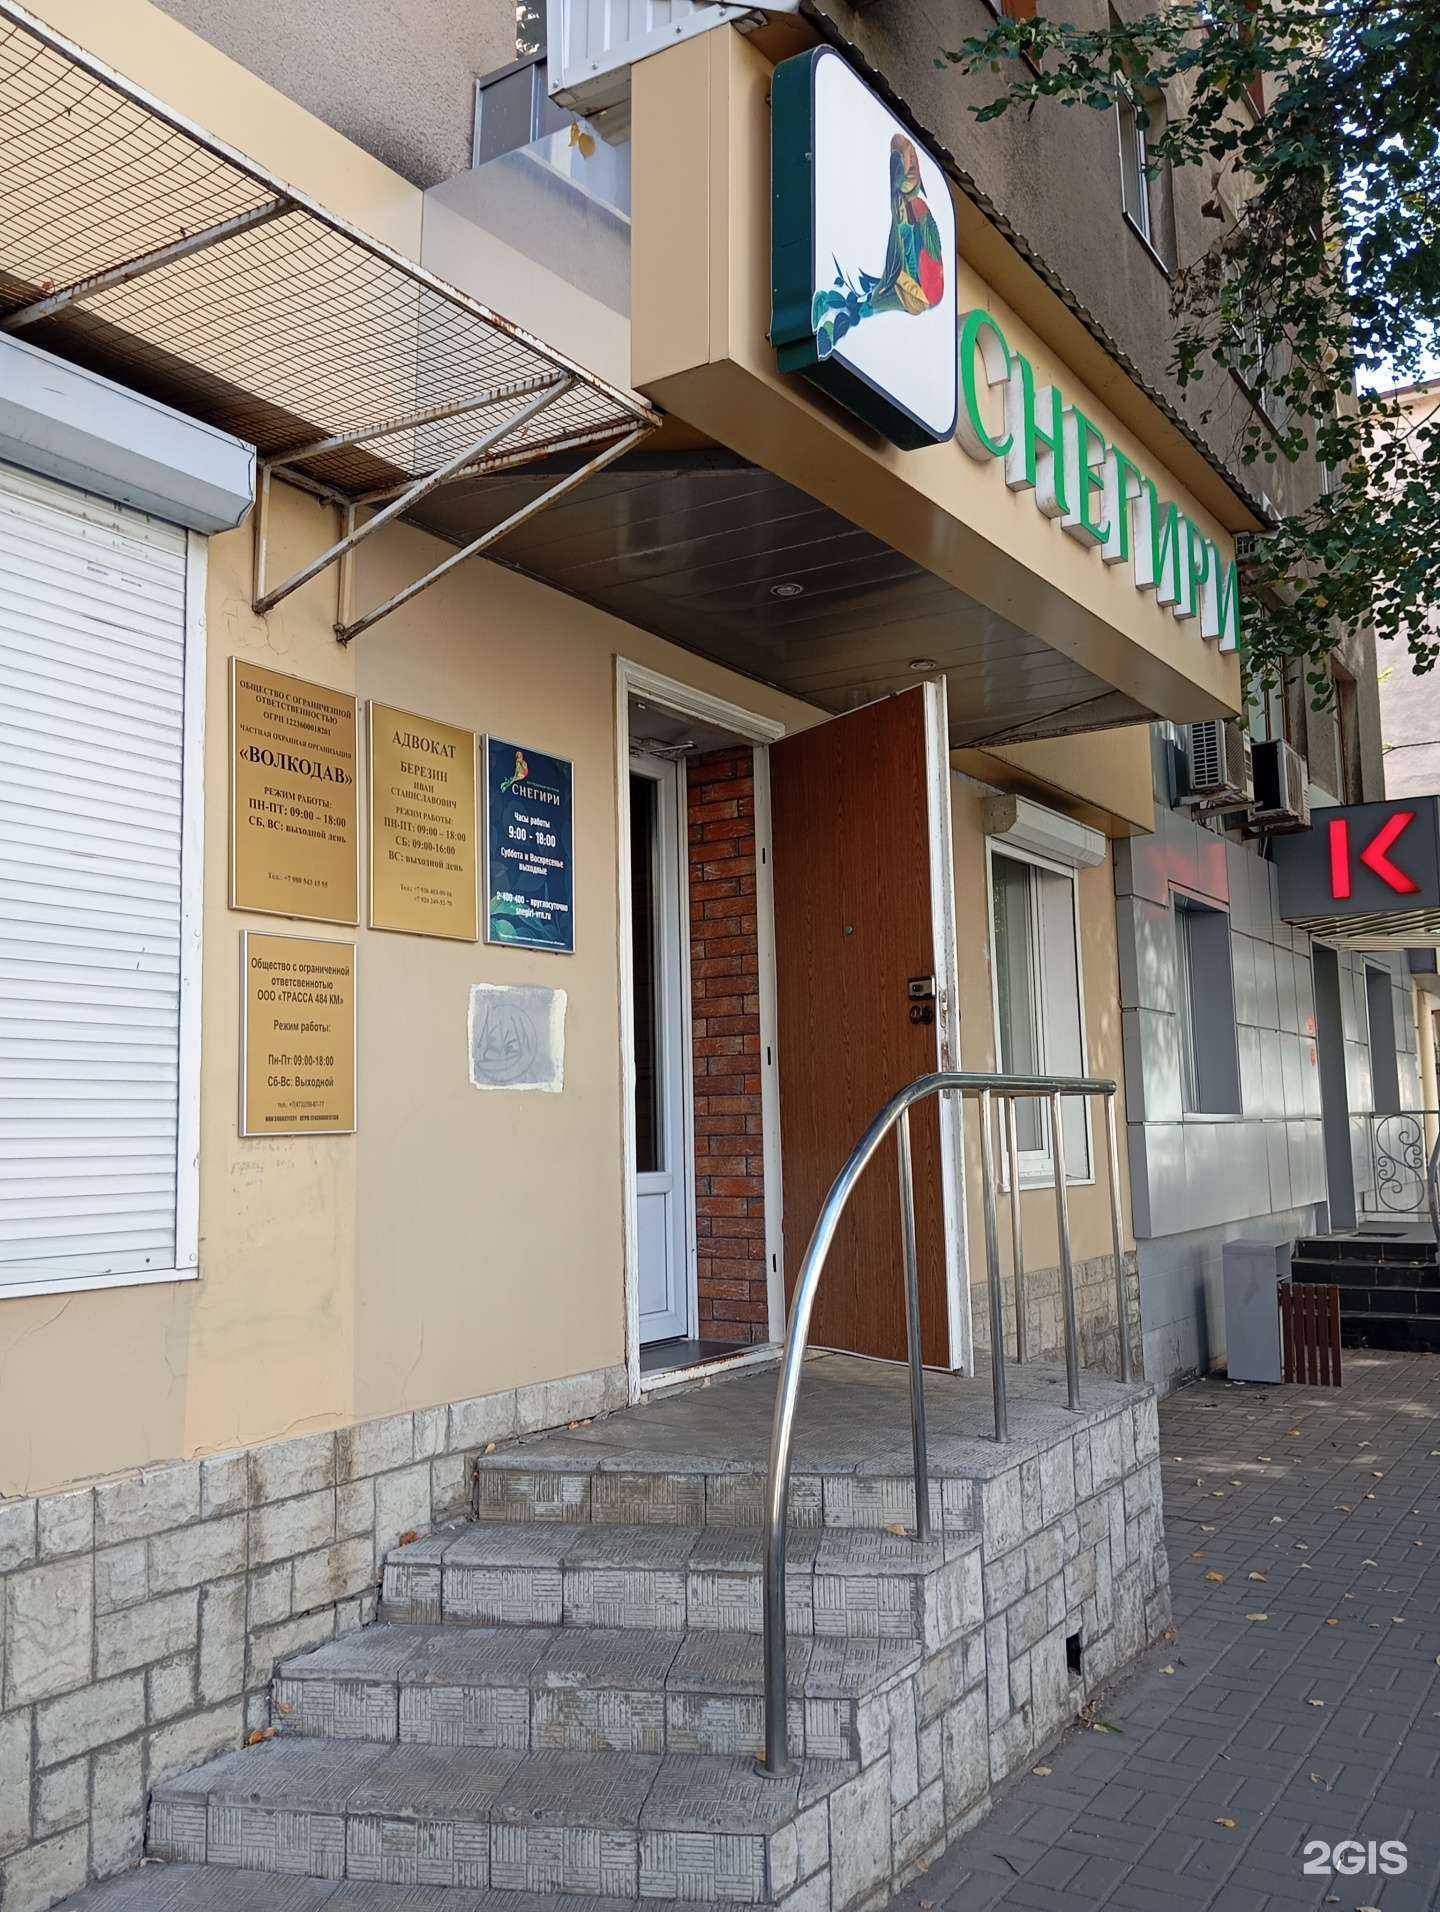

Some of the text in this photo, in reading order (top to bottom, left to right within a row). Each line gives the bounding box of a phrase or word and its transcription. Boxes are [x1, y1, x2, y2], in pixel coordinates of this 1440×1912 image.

[955, 308, 1241, 655] СНЕГИРИ
[239, 679, 352, 719] ОБЩЕСТВО С ОГРАНИЧЕННОЙ
[255, 695, 338, 725] ОТВЕТСТВЕННОСТЬЮ
[263, 711, 284, 723] ОГРН
[239, 723, 272, 739] ЧАСТНАЯ
[392, 729, 457, 759] АДВОКАТ
[239, 745, 353, 785] «ВОЛКОДАВ»
[400, 761, 448, 783] БЕРЕЗИН
[264, 786, 333, 808] РЕЖИМ РАБОТЫ:
[390, 786, 457, 809] СТАНИСЛАВОВИЧ
[413, 781, 434, 794] ИВАН
[511, 783, 560, 806] СНЕГИРИ
[248, 798, 288, 816] ПН-ПТ:
[290, 806, 314, 821] 09:00
[324, 814, 346, 828] 18:00
[395, 806, 422, 818] РЕЖИМ
[514, 811, 551, 828] Часы работы
[267, 819, 284, 831] ВС:
[384, 816, 415, 832] ПН-ПТ:
[417, 825, 438, 837] 09:00
[446, 830, 466, 842] 18:00
[395, 835, 456, 855] СБ: 09:00-16:00
[508, 825, 527, 840] 9:00
[535, 832, 556, 848] 18:00
[388, 850, 404, 862] ВС:
[500, 846, 523, 860] Суббота
[530, 898, 568, 912] круглосуточно
[250, 957, 350, 977] Общество с ограниченной
[257, 988, 344, 1005] ООО «ТРАССА 484 КМ»
[273, 1019, 331, 1034] Режим работы:
[293, 1055, 334, 1066] 09:00-18:00
[267, 1075, 334, 1088] Сб-Вс: Выходной
